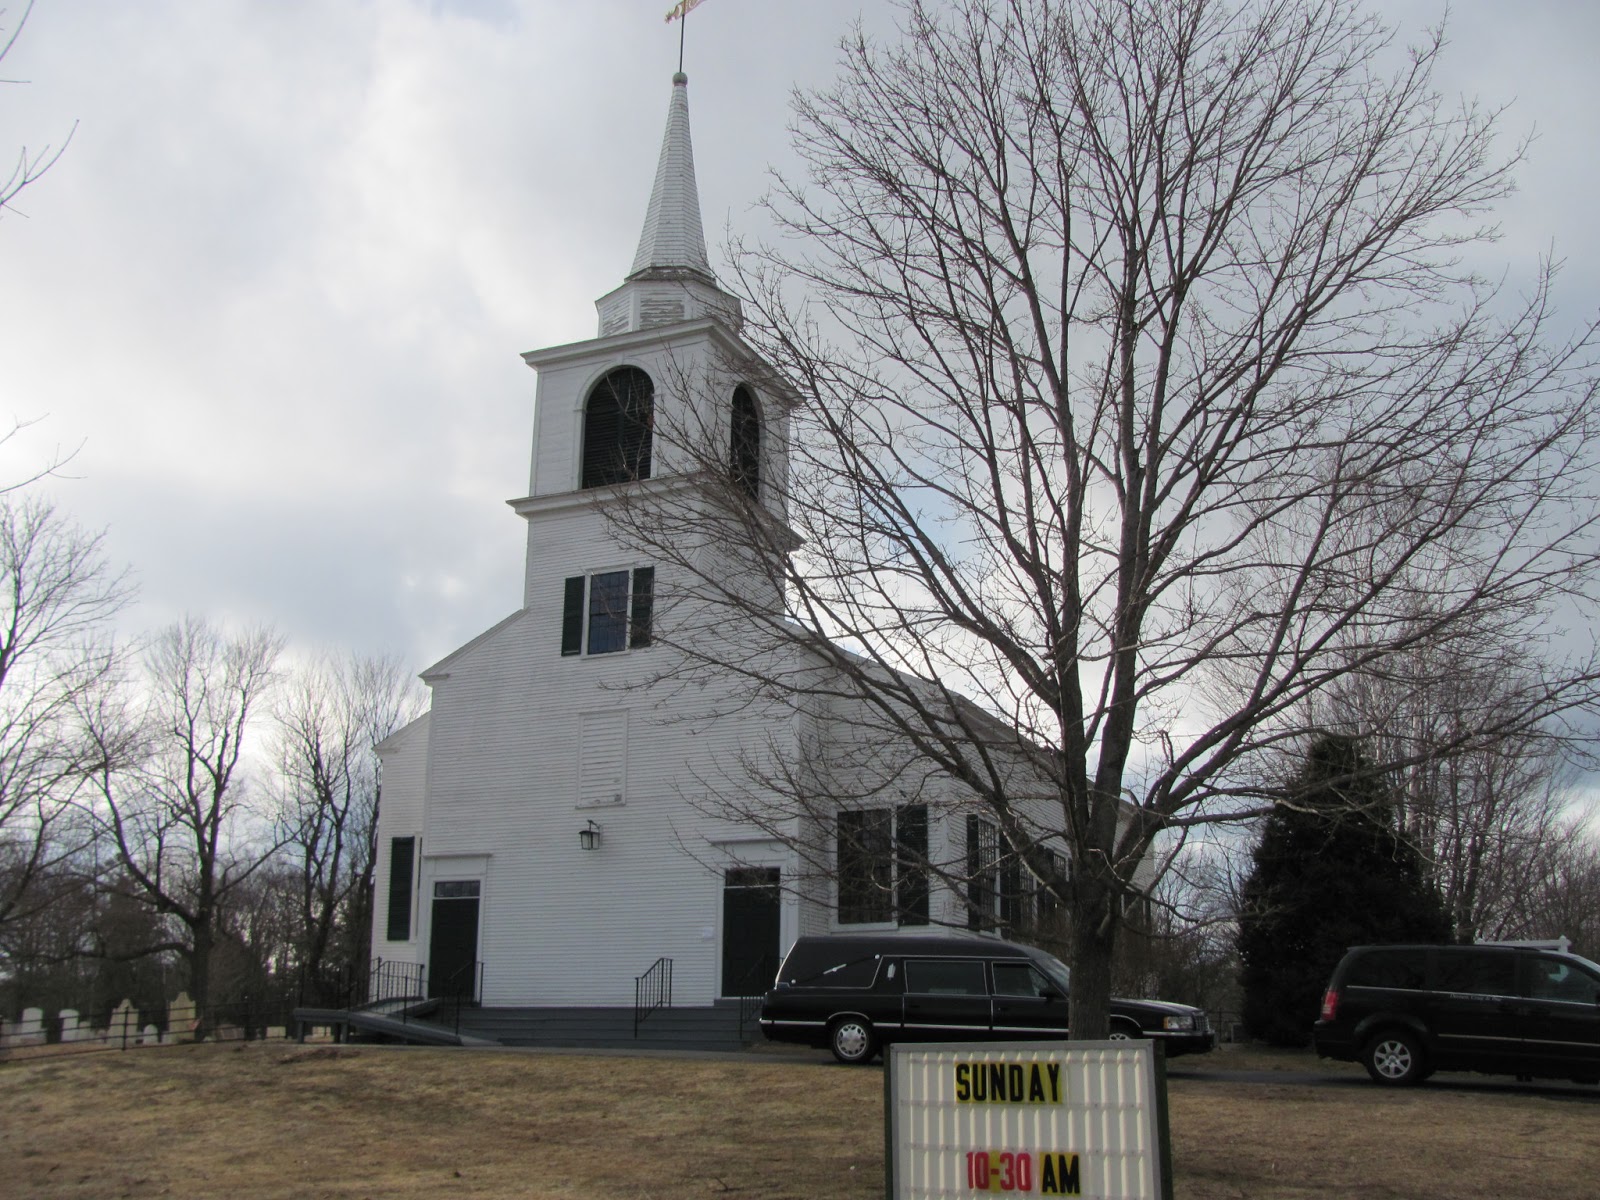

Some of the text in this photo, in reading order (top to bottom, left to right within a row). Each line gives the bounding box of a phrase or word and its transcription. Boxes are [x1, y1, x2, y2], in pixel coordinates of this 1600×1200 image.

[955, 1063, 1060, 1102] SUNDAY
[966, 1152, 1080, 1194] 10-30 AM
